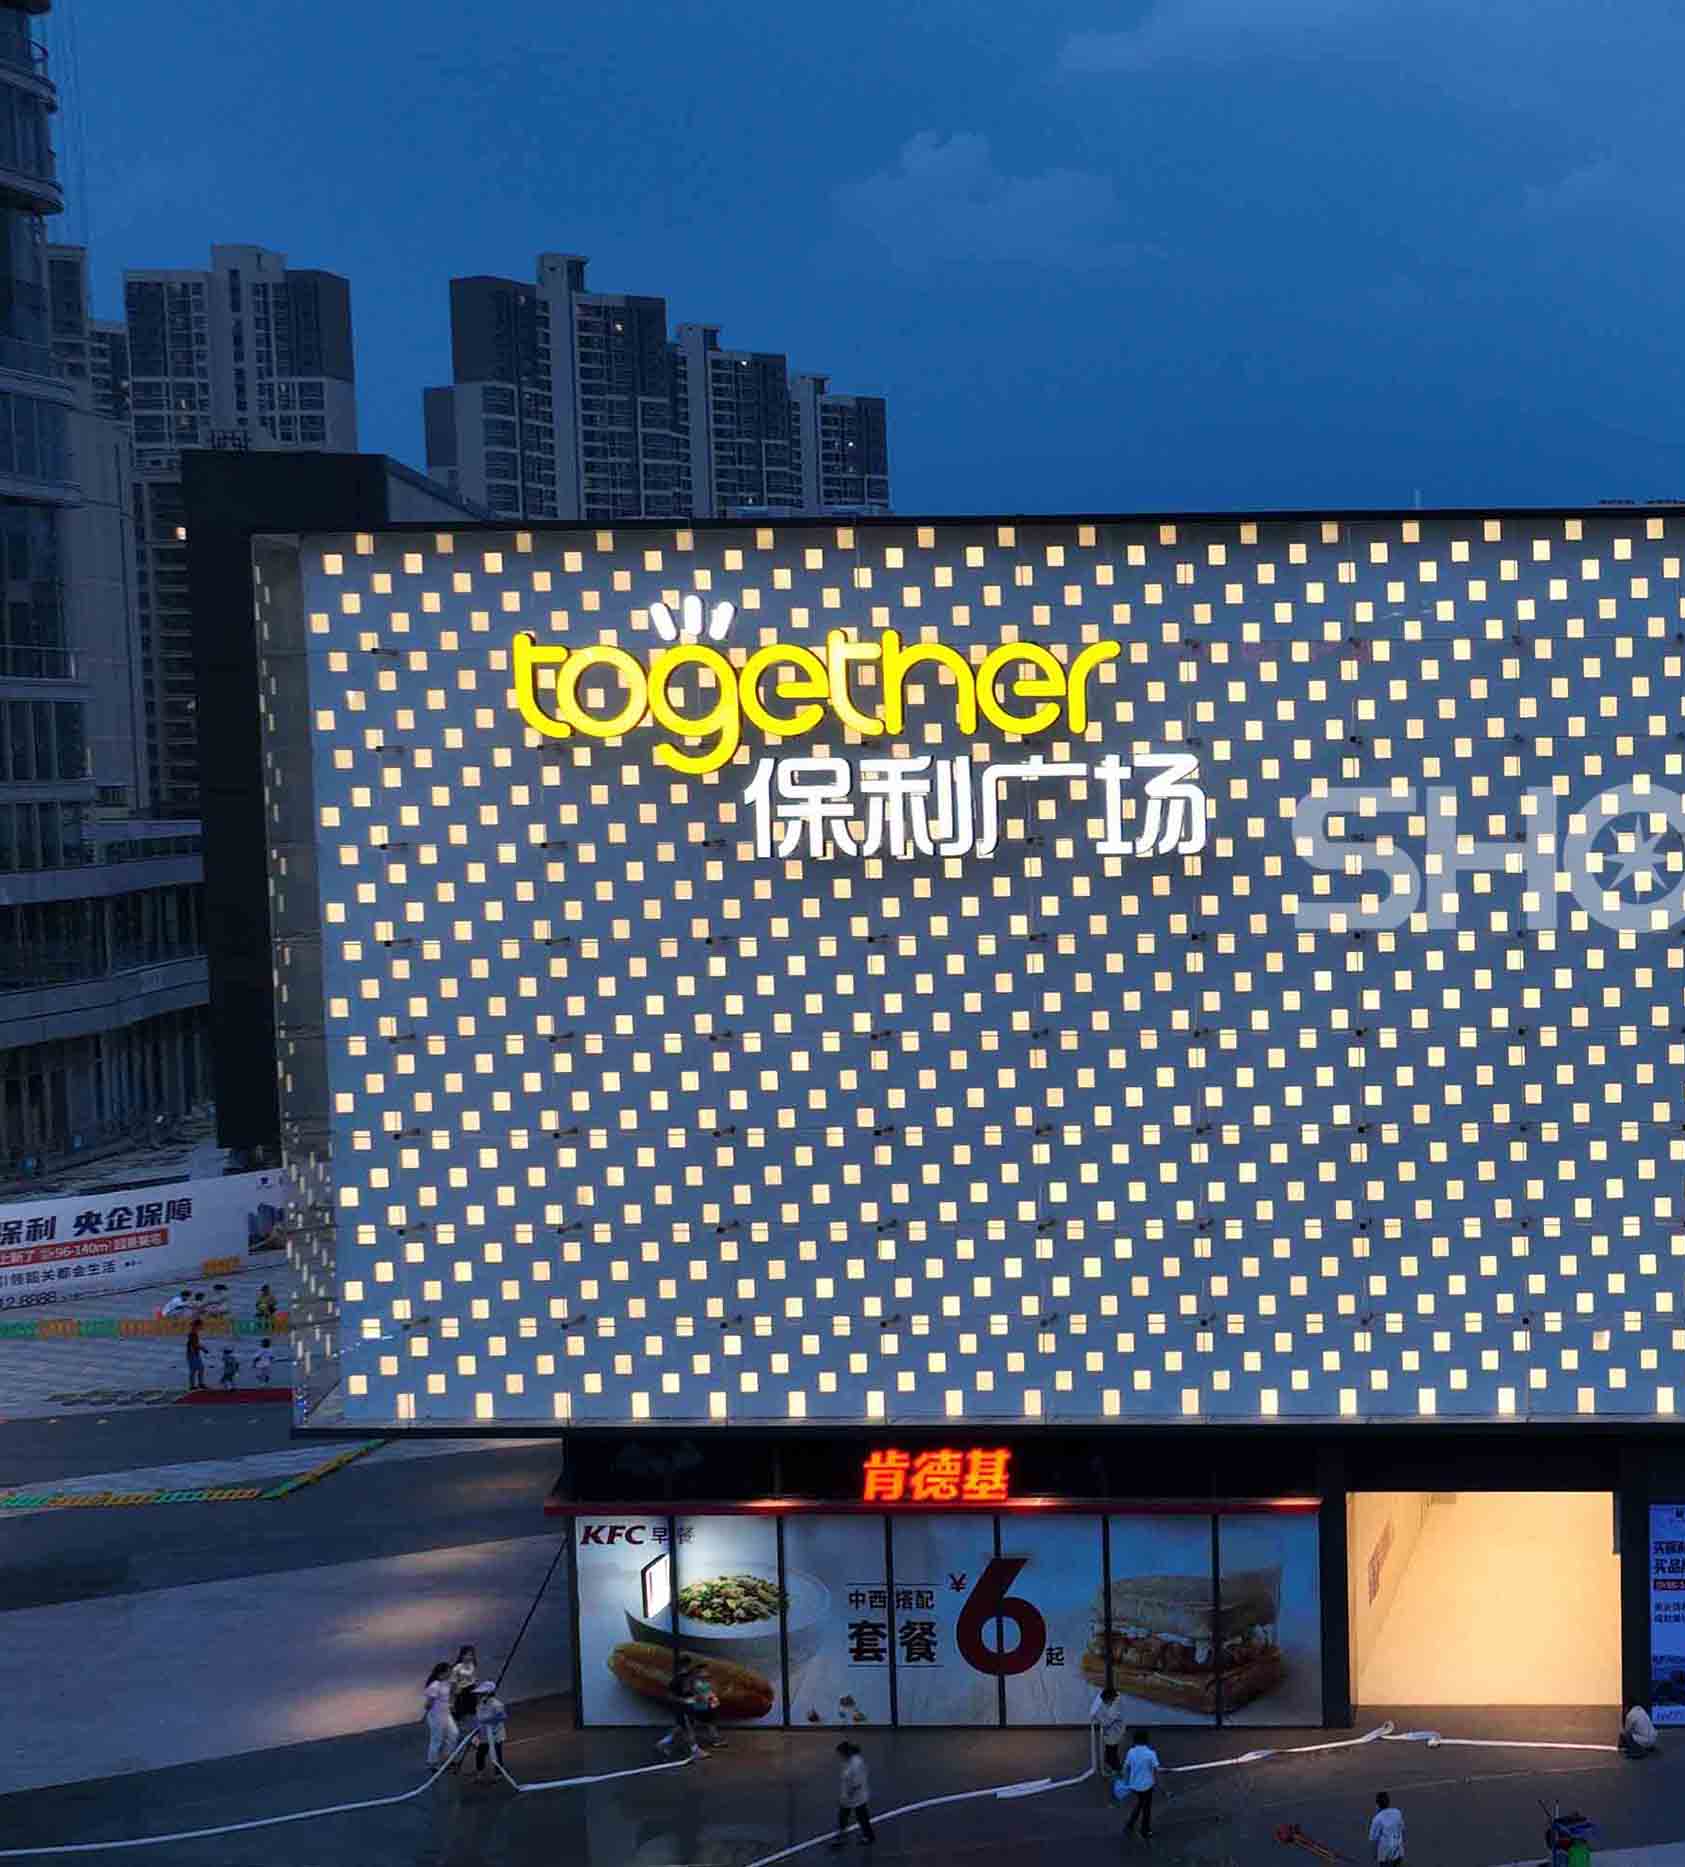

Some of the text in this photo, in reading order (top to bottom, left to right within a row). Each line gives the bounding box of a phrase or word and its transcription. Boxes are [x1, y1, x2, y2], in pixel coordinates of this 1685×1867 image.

[512, 630, 1121, 774] together
[744, 753, 1208, 859] 保利广场
[73, 1198, 192, 1237] 央企保障
[864, 1446, 1012, 1501] 肯德基
[579, 1524, 646, 1546] KFC
[848, 1588, 935, 1611] 中西搭配
[847, 1620, 938, 1664] 套餐
